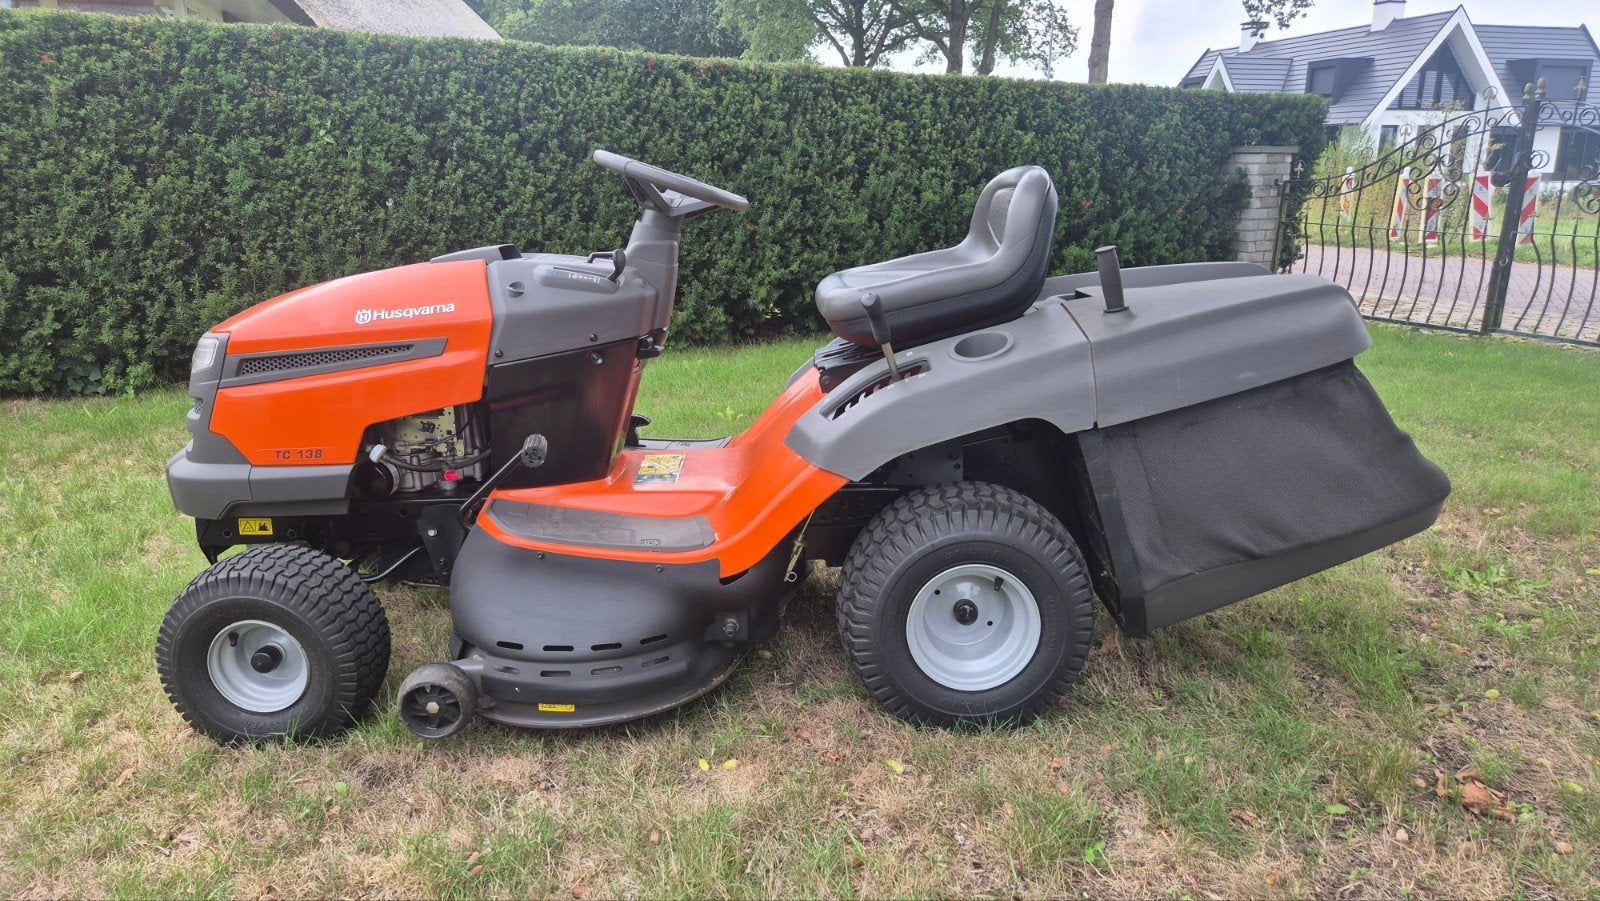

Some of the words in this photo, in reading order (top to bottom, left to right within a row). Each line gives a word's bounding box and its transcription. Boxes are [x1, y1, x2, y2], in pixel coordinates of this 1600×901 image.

[373, 303, 455, 320] Husqvarna
[275, 450, 291, 460] TC
[297, 449, 323, 459] 138
